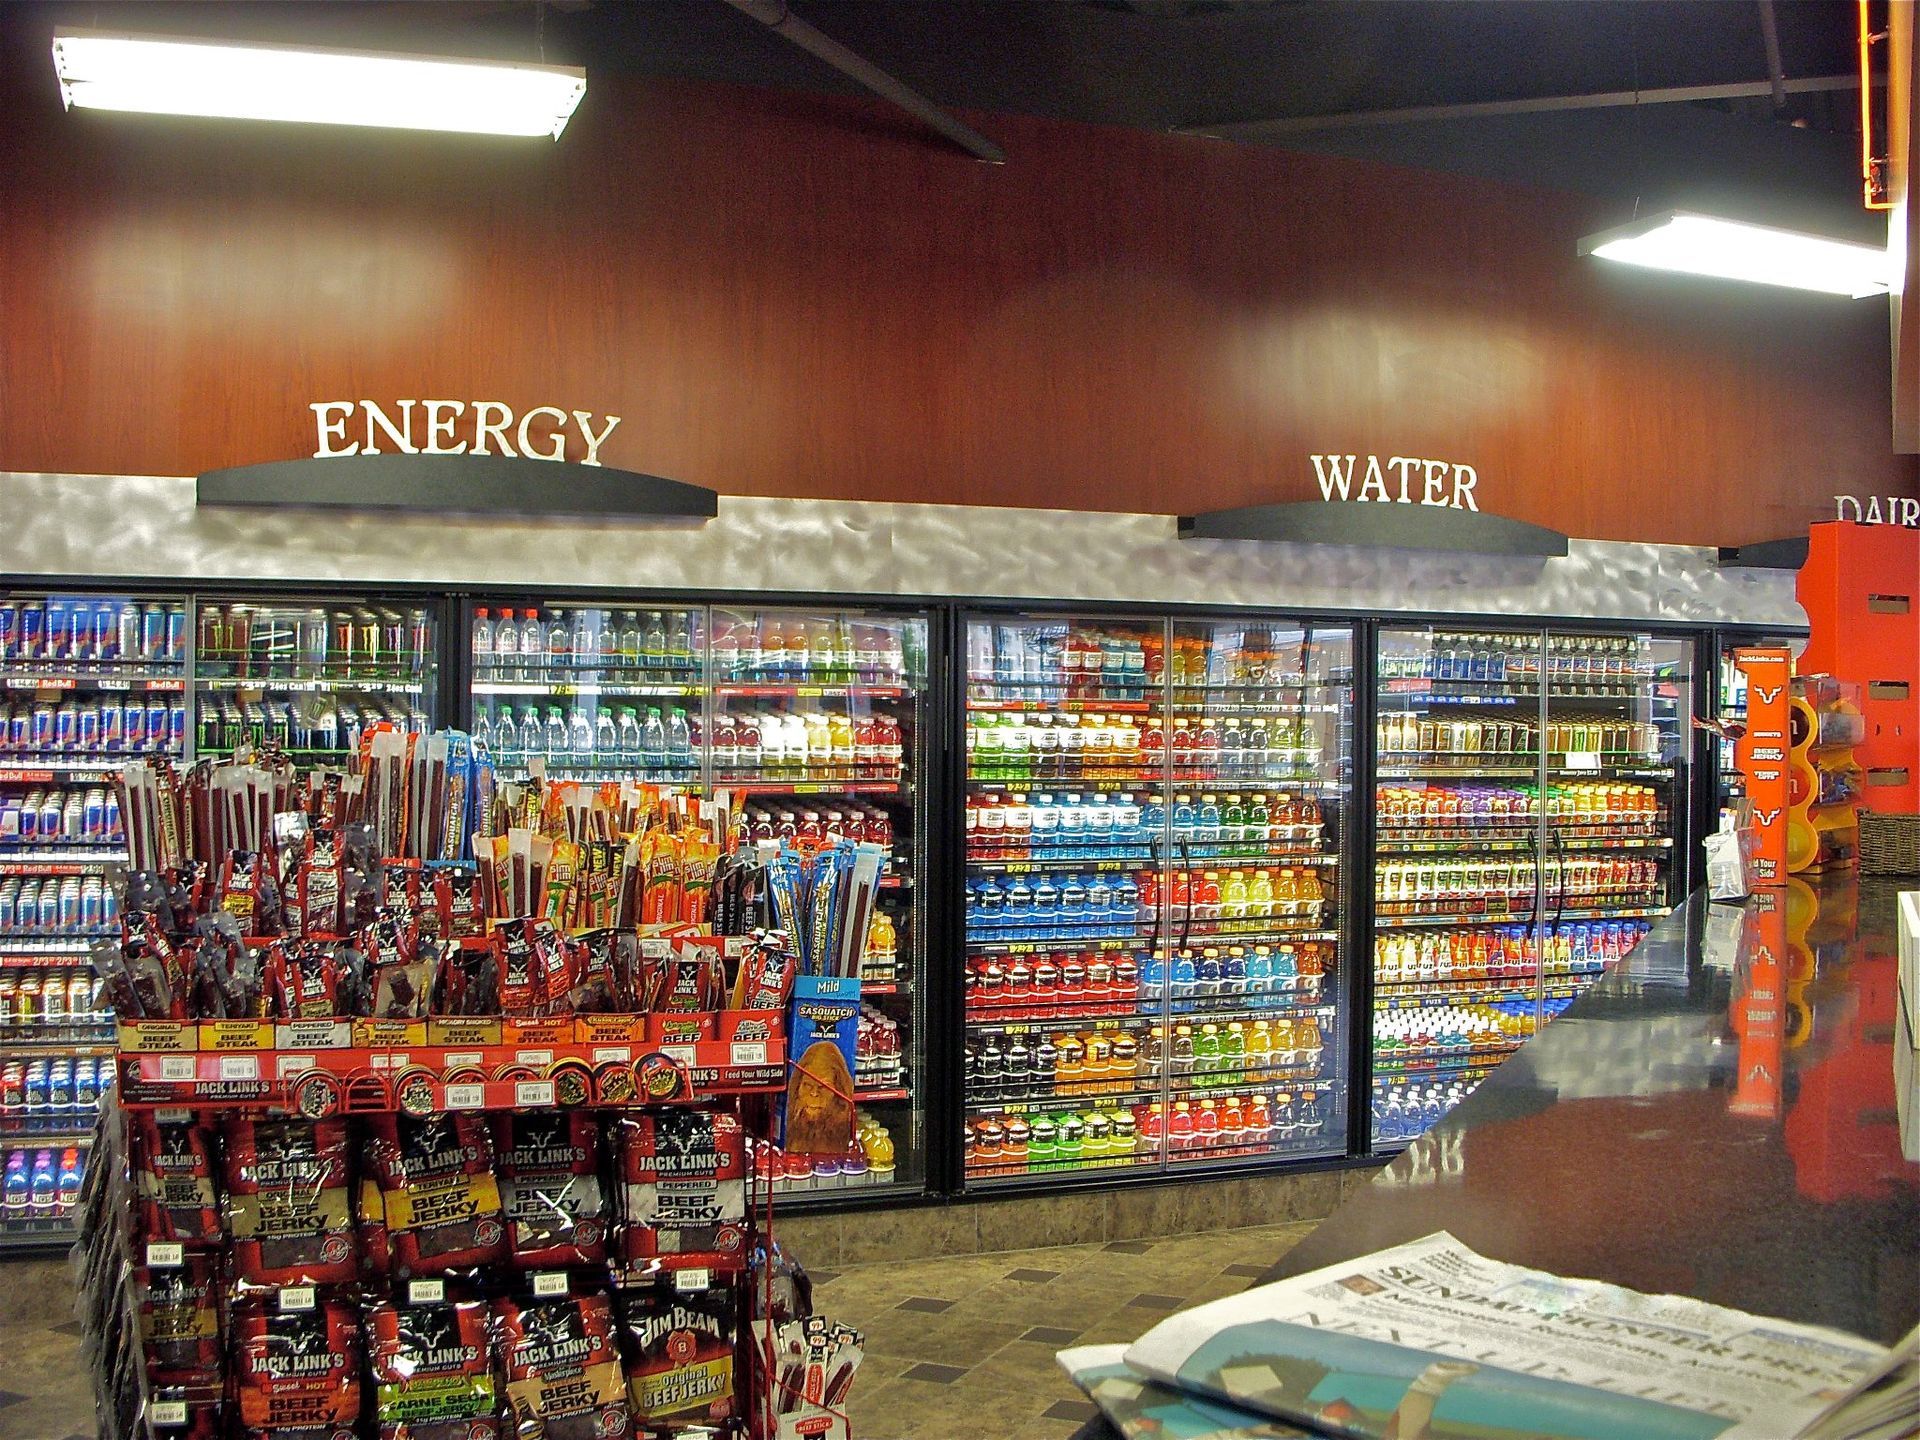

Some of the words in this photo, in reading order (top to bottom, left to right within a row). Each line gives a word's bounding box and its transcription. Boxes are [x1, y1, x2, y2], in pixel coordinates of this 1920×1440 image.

[309, 399, 621, 467] ENERGY
[1310, 455, 1479, 512] WATER
[446, 802, 458, 858] SASQUATCH
[594, 848, 604, 873] NEW
[613, 852, 622, 879] NEW
[1760, 868, 1775, 878] Side
[765, 970, 783, 981] JACK
[760, 977, 783, 989] LINK'S
[817, 980, 840, 994] Mild
[674, 986, 698, 994] LINK'S
[751, 999, 783, 1010] BEEF
[800, 1007, 854, 1017] SASQUATCH
[590, 1034, 631, 1042] STEAK
[663, 1032, 702, 1043] BEEF
[733, 1032, 771, 1041] BEEF
[138, 1041, 182, 1049] STEAK
[215, 1040, 258, 1048] STEAK
[691, 1069, 719, 1081] INK'S
[725, 1071, 740, 1079] Feed
[741, 1070, 756, 1079] Your
[756, 1070, 770, 1078] Wild
[770, 1069, 783, 1078] Side
[195, 1082, 227, 1094] JACK
[154, 1155, 174, 1166] JACK
[389, 1157, 425, 1177] JACK
[429, 1146, 478, 1167] LINK'S
[499, 1151, 534, 1166] JACK
[537, 1147, 586, 1163] LINK'S
[640, 1156, 678, 1172] JACK
[680, 1152, 731, 1169] LINK'S
[241, 1164, 280, 1181] JACK
[520, 1174, 568, 1183] PEPPERED
[165, 1184, 198, 1194] BEEF
[662, 1181, 712, 1189] PEPPERED
[411, 1189, 470, 1211] BEEF
[515, 1187, 573, 1200] BEEF
[509, 1199, 582, 1214] JERKY
[657, 1194, 716, 1207] BEEF
[259, 1203, 319, 1219] BEEF
[408, 1200, 480, 1225] JERKY
[651, 1206, 725, 1220] JERKY
[254, 1215, 329, 1232] JERKY
[680, 1220, 712, 1228] PROTEIN
[283, 1231, 317, 1240] PROTEIN
[641, 1316, 673, 1350] JIM
[673, 1306, 720, 1338] BEAM
[513, 1347, 551, 1367] JACK
[552, 1336, 602, 1357] LINK'S
[678, 1342, 687, 1352] B
[426, 1345, 478, 1366] LINK'S
[534, 1360, 567, 1370] PREMIUM
[568, 1354, 588, 1362] CUTS
[252, 1354, 290, 1373] JACK
[294, 1352, 344, 1371] LINK'S
[662, 1365, 708, 1386] Original
[272, 1381, 301, 1392] Sweet
[305, 1381, 327, 1391] HOT
[540, 1381, 592, 1401] BEEF
[643, 1389, 680, 1409] BEEF
[680, 1373, 728, 1400] JERKY
[270, 1395, 330, 1411] BEEF
[435, 1402, 477, 1415] JERKY
[536, 1390, 601, 1416] JERKY
[263, 1407, 340, 1424] JERKY
[432, 1413, 463, 1422] PROTEIN
[563, 1406, 594, 1418] PROTEIN
[292, 1424, 326, 1432] PROTEIN
